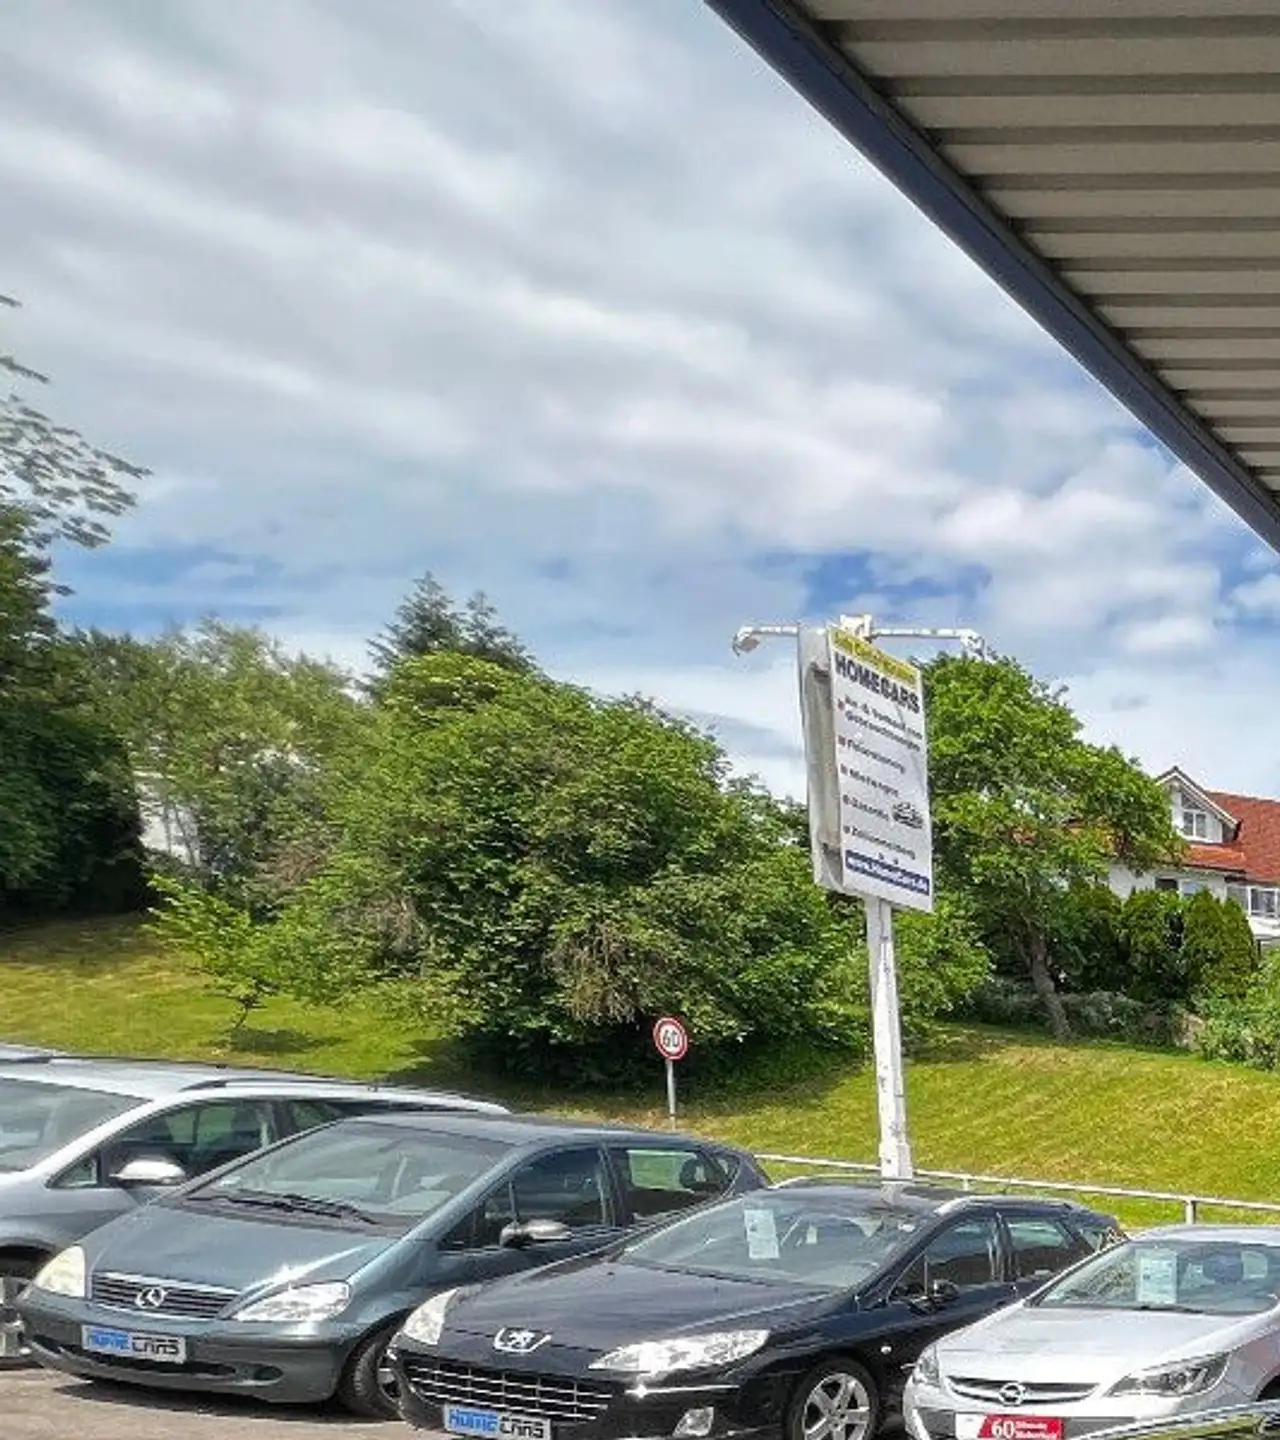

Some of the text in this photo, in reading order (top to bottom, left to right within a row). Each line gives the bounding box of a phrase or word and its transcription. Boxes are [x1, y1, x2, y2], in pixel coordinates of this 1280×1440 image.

[835, 651, 920, 714] HOMECARS
[663, 1029, 681, 1048] 60
[991, 1419, 1015, 1439] 60
